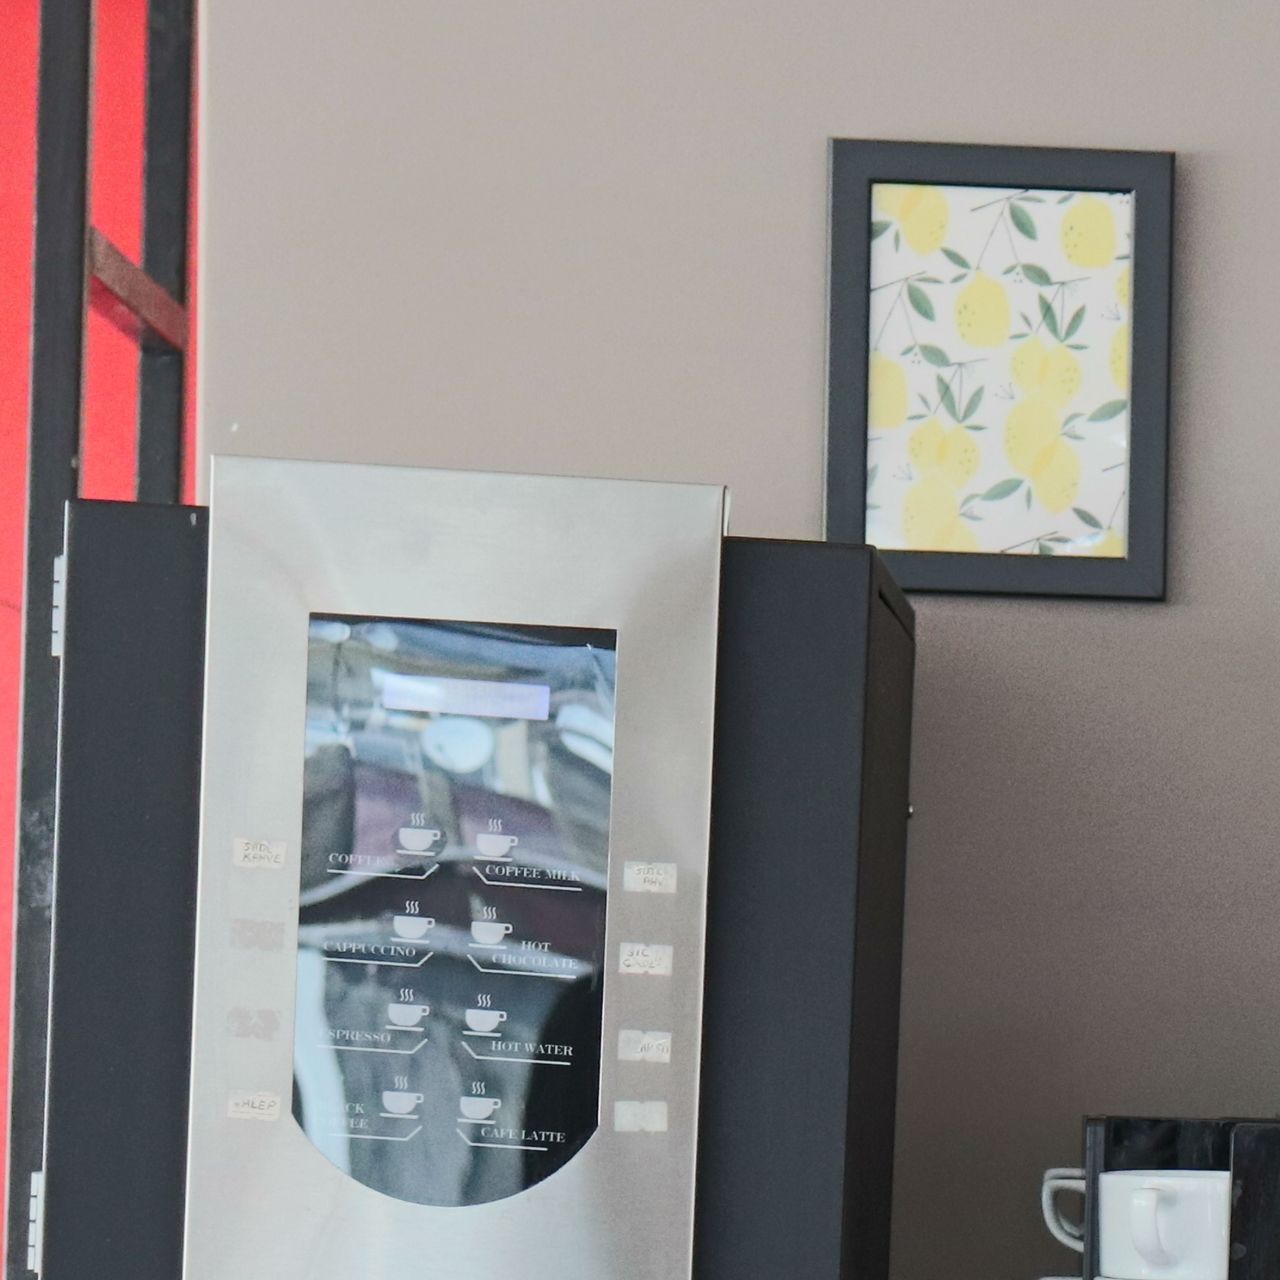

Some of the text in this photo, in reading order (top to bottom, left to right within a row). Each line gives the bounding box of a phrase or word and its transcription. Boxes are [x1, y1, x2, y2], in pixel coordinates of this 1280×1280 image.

[485, 865, 582, 882] COFFEE MILK
[323, 941, 416, 958] CAPPUCCINO
[521, 940, 551, 952] HOT
[491, 953, 578, 970] CHOCOLATE
[320, 1029, 391, 1043] SPRESSO
[491, 1041, 574, 1056] HOT WATER
[521, 1129, 566, 1143] LATTE
